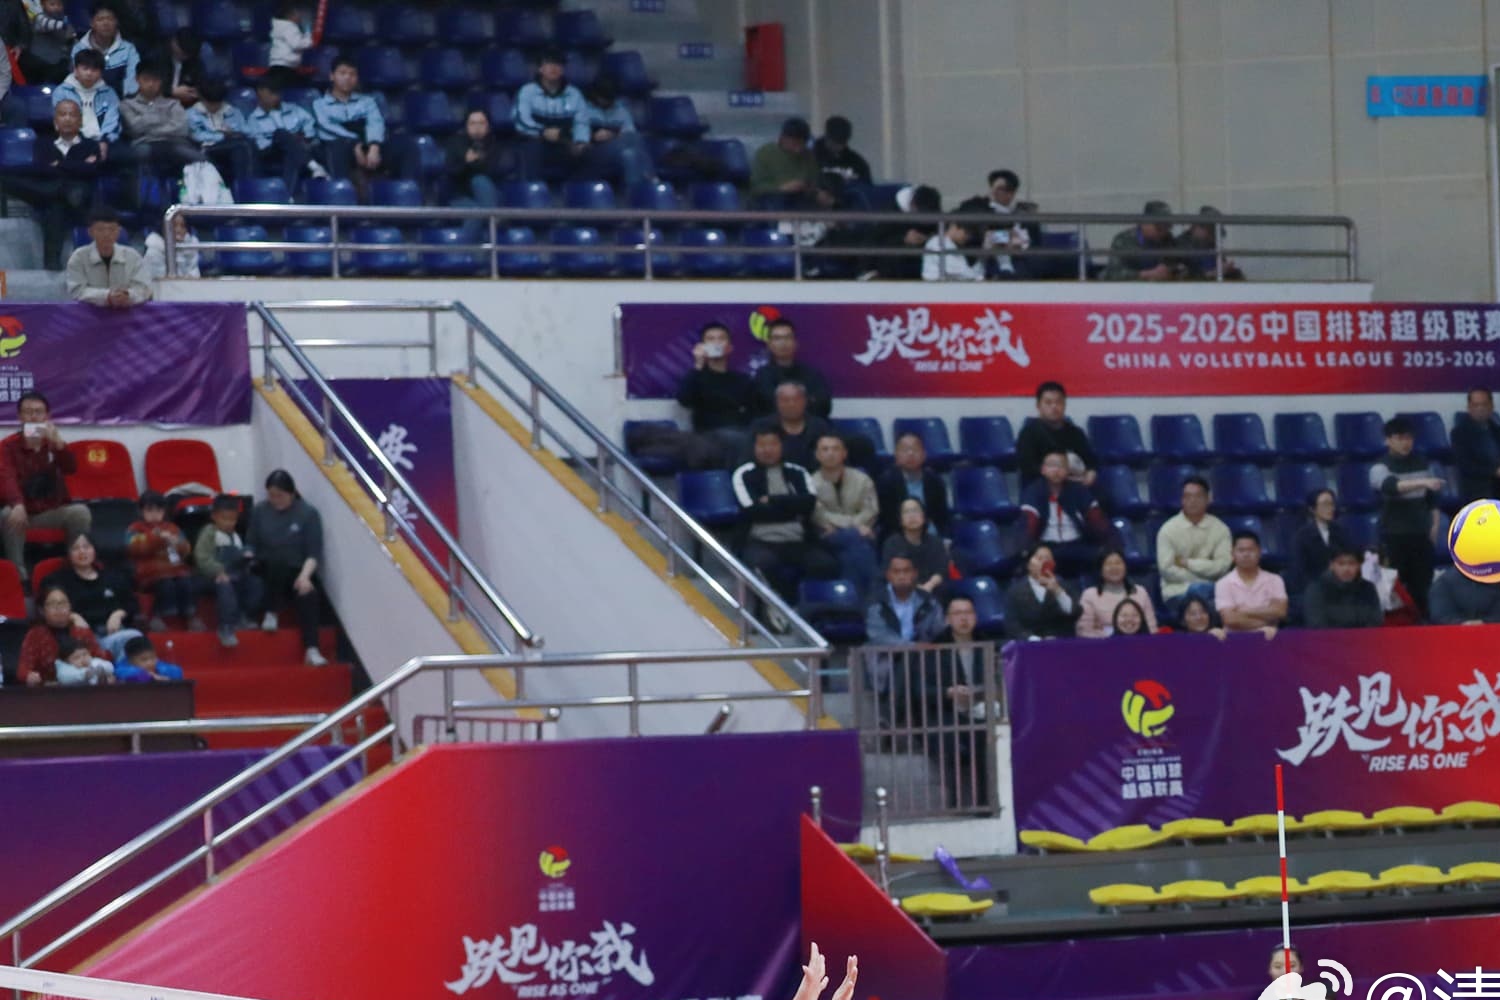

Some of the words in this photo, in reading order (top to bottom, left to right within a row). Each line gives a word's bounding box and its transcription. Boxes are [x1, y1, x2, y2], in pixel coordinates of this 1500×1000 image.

[1103, 352, 1171, 369] CHINA
[1179, 351, 1307, 369] VOLLEYBALL
[1315, 350, 1395, 367] LEAGUE
[1402, 350, 1496, 367] 2025-2026
[1369, 755, 1405, 772] RISE
[1408, 754, 1430, 770] AS
[1433, 752, 1469, 769] ONE
[518, 984, 546, 999] RISE
[549, 983, 567, 996] AS
[569, 982, 599, 996] ONE
